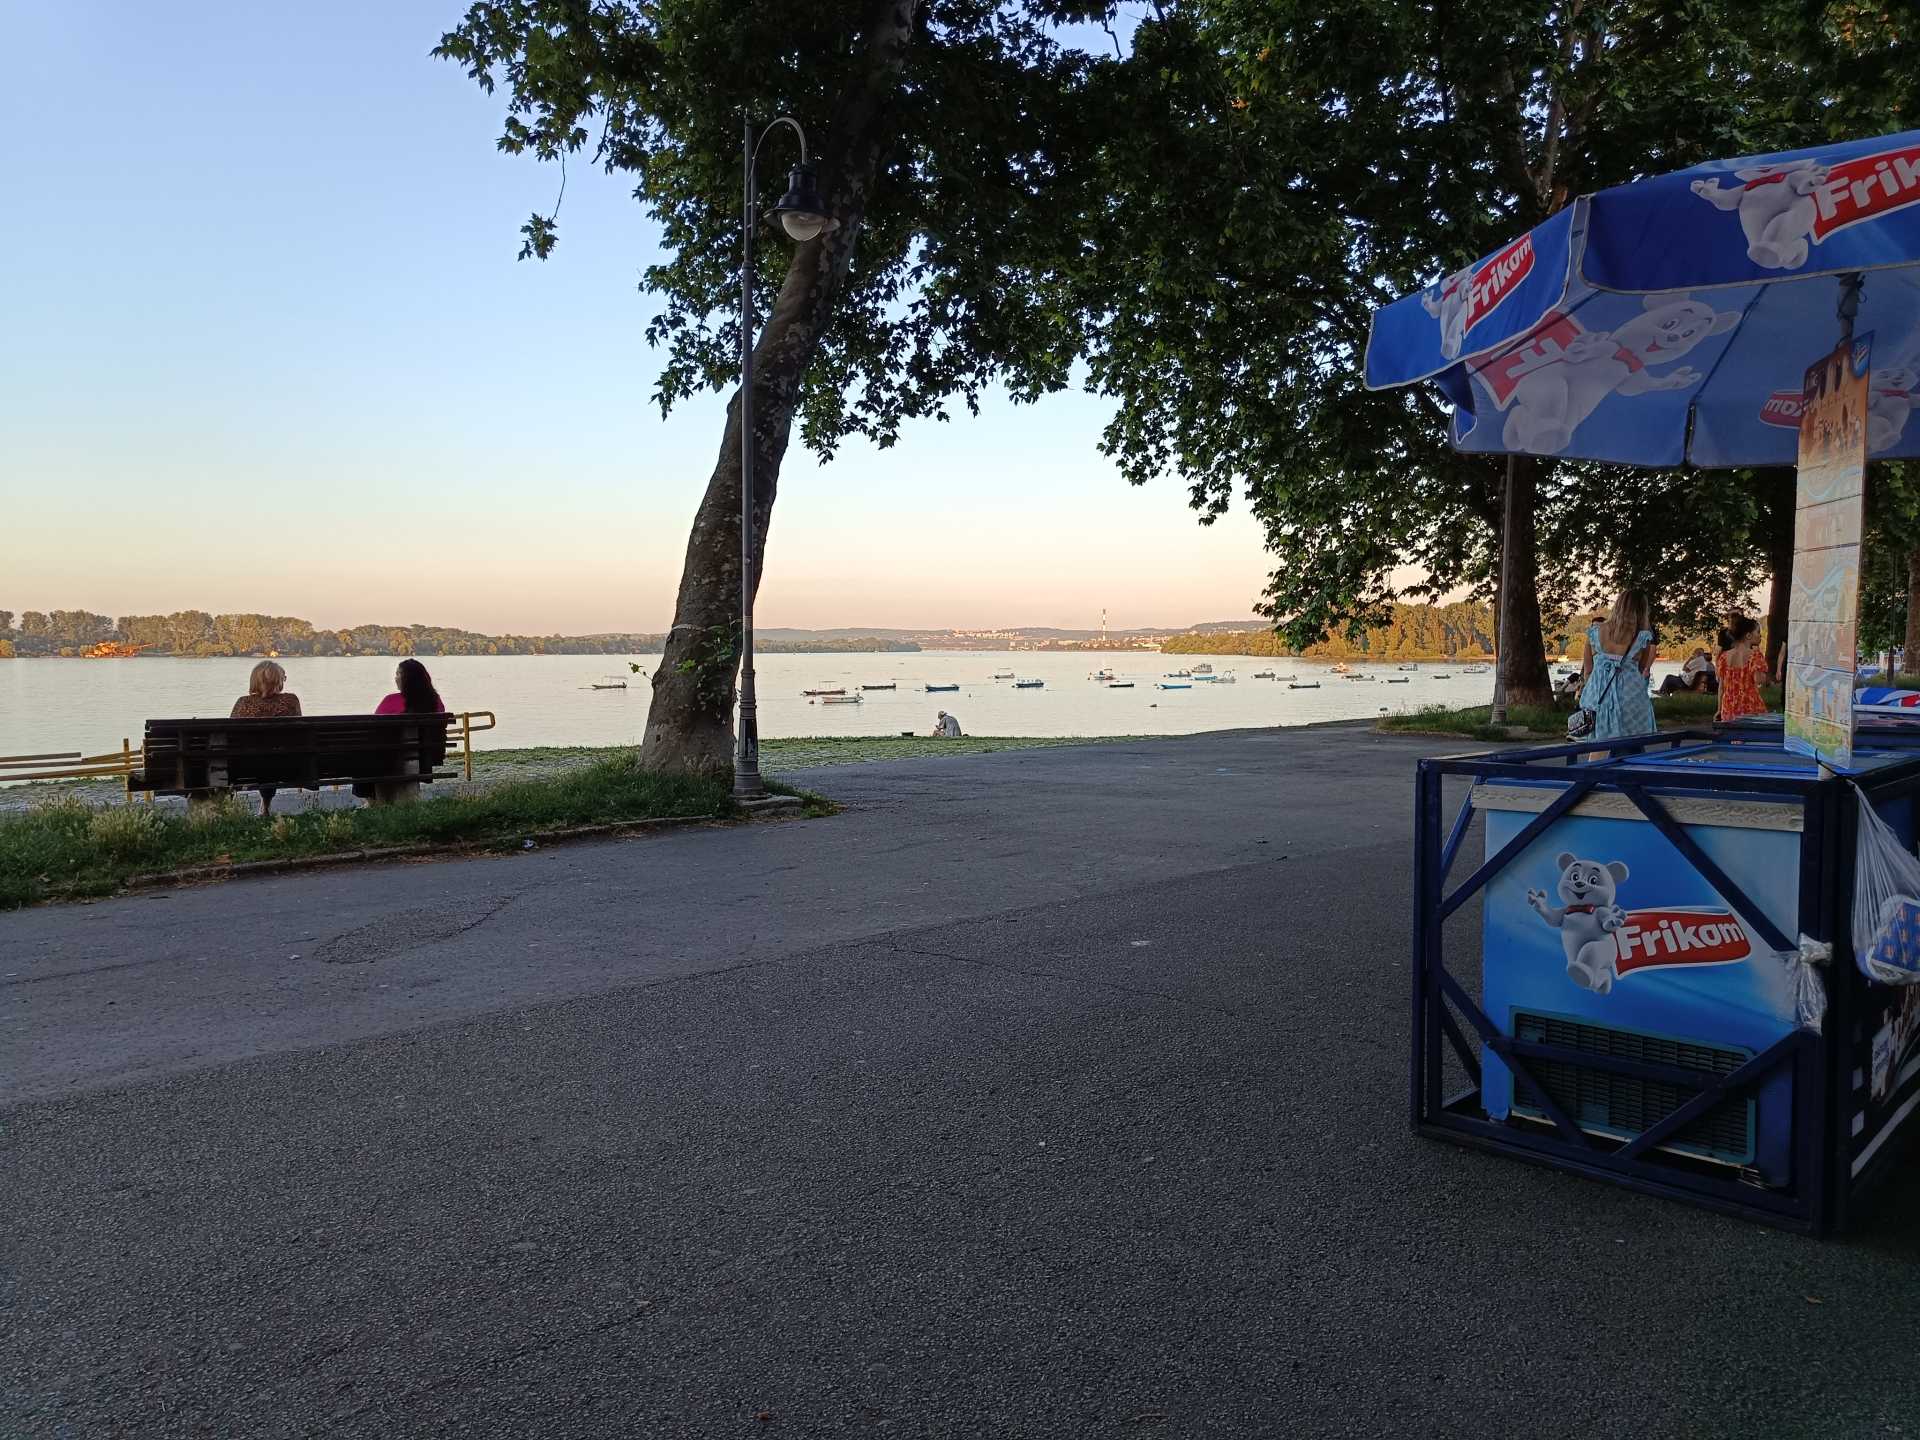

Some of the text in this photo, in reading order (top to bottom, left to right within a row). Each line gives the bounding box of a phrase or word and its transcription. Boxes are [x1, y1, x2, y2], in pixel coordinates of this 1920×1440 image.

[1814, 157, 1920, 221] Frik
[1466, 238, 1532, 321] Frikom
[1615, 919, 1745, 960] Frikom
